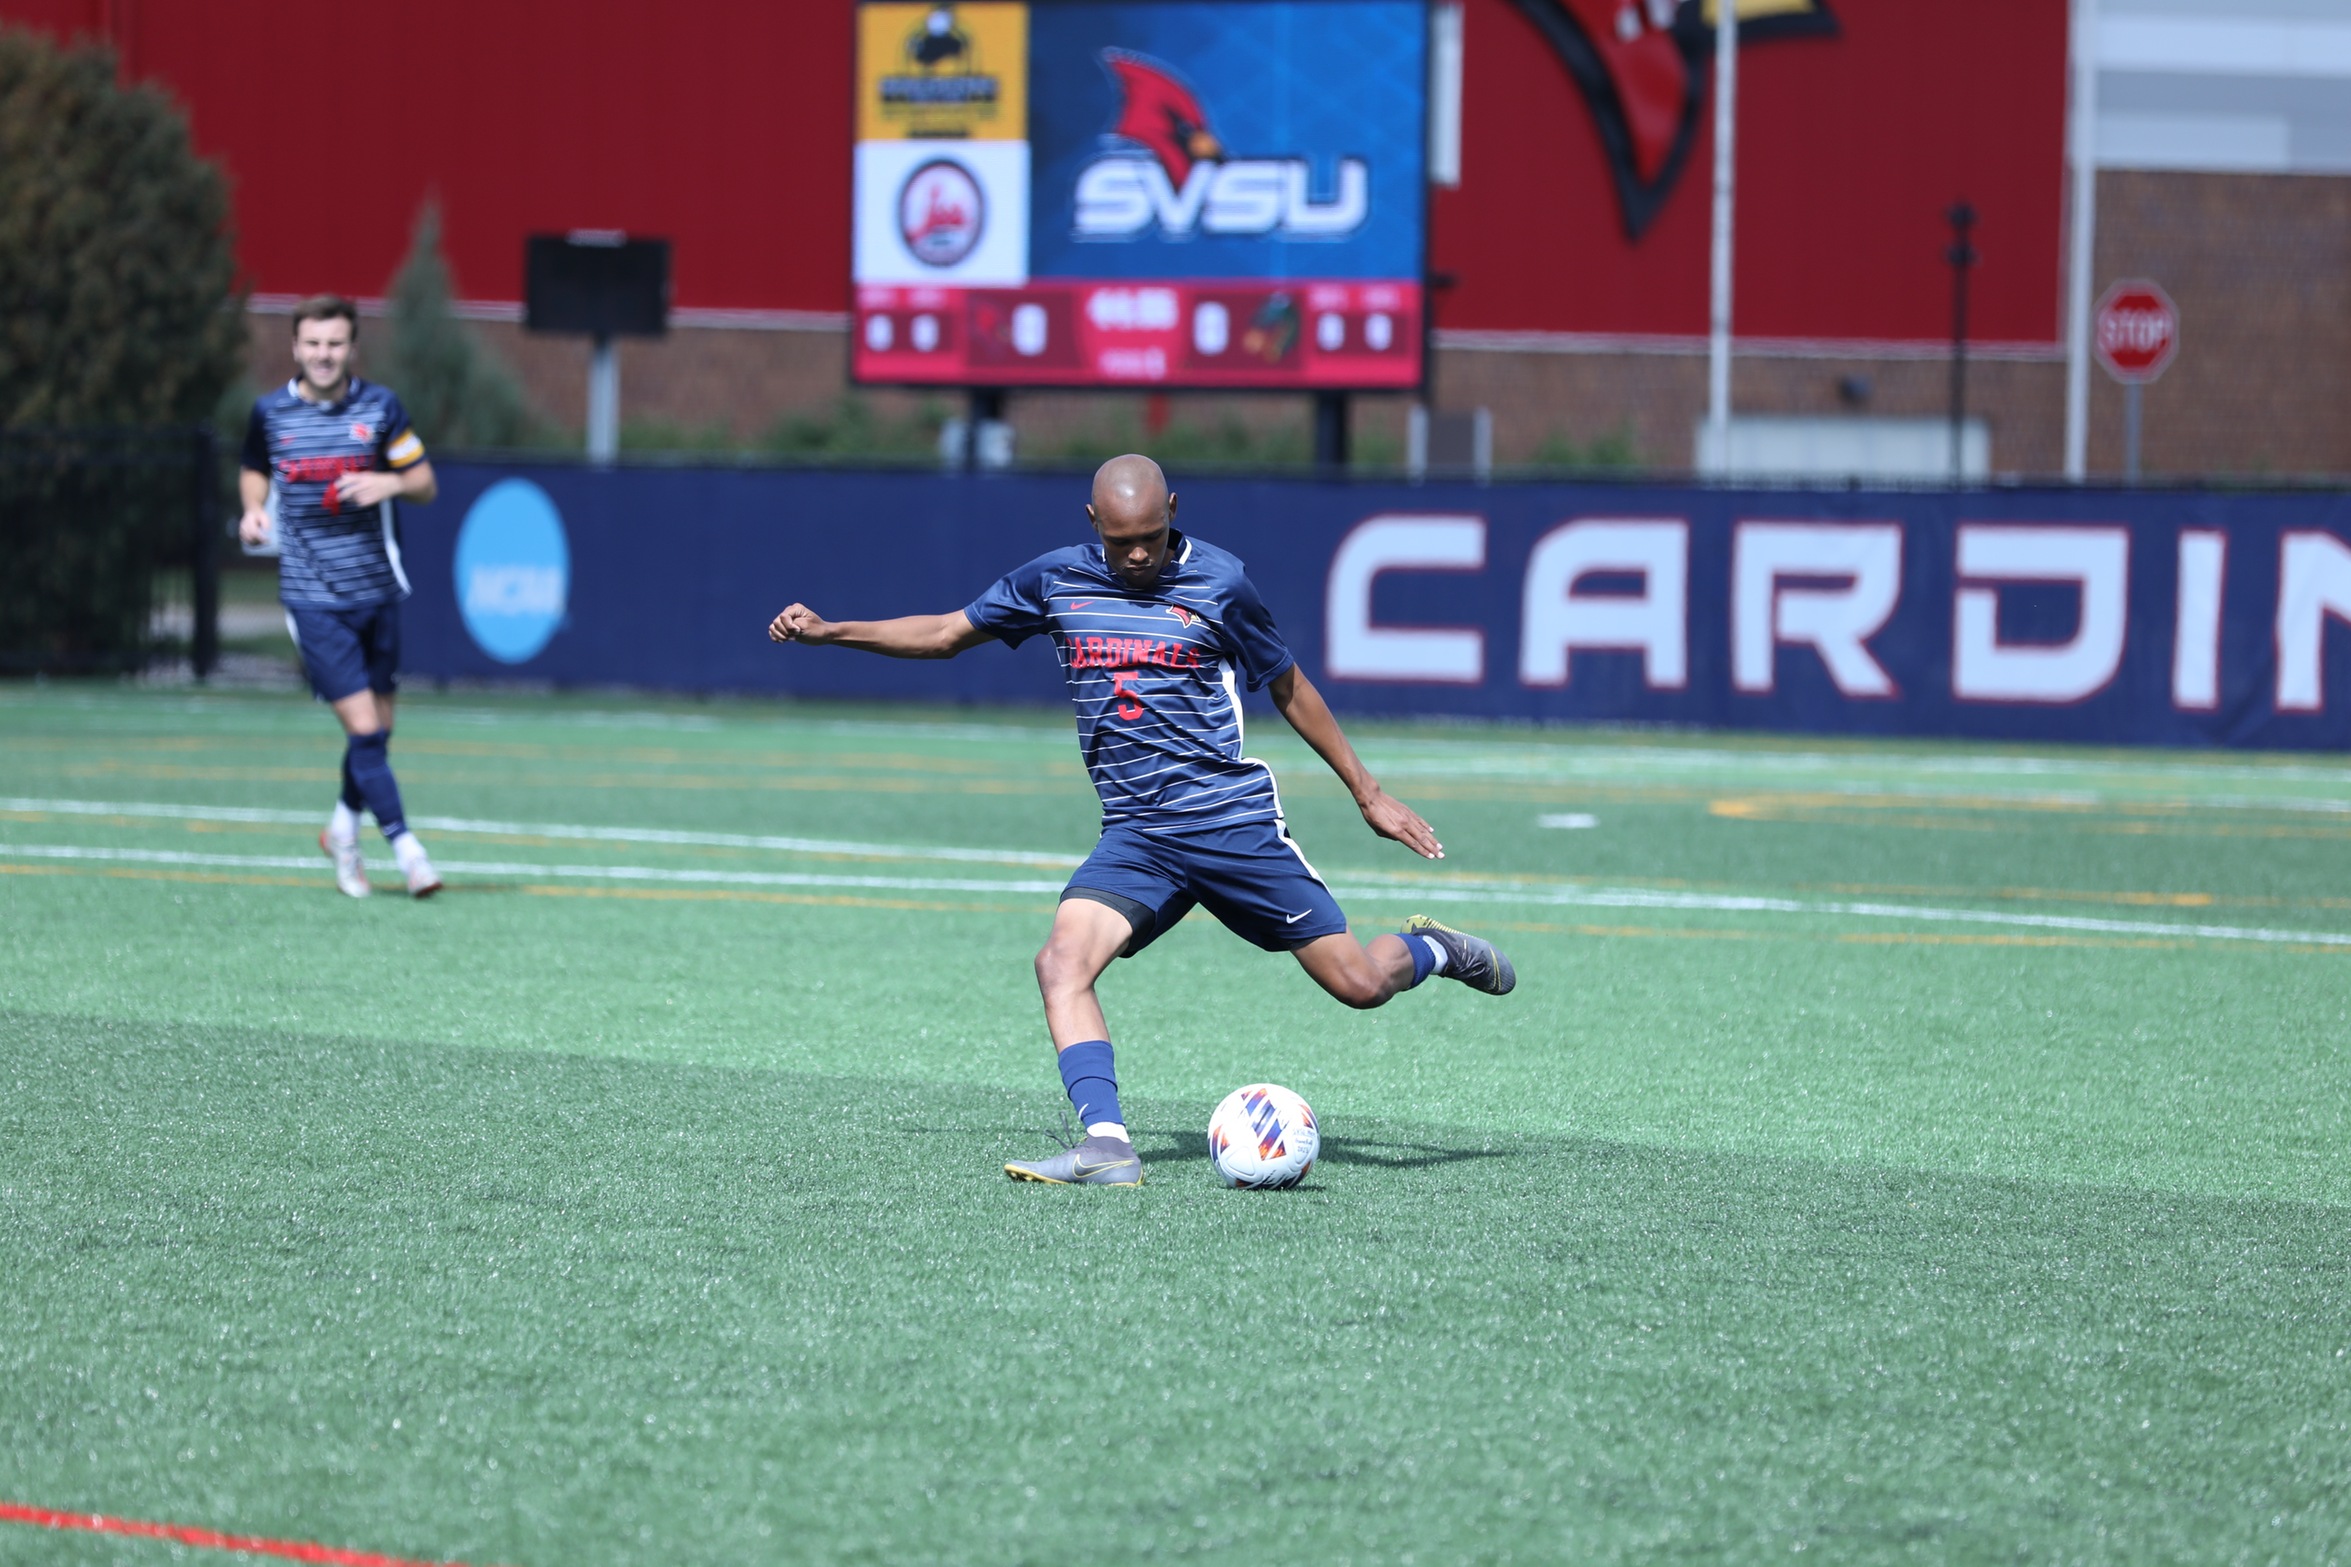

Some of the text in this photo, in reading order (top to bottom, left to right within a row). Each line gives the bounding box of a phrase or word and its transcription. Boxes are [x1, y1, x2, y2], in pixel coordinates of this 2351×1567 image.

[1075, 158, 1367, 236] SVSU
[2101, 309, 2171, 350] STOP
[1066, 635, 1201, 669] CARDINALS
[1113, 671, 1144, 721] 5
